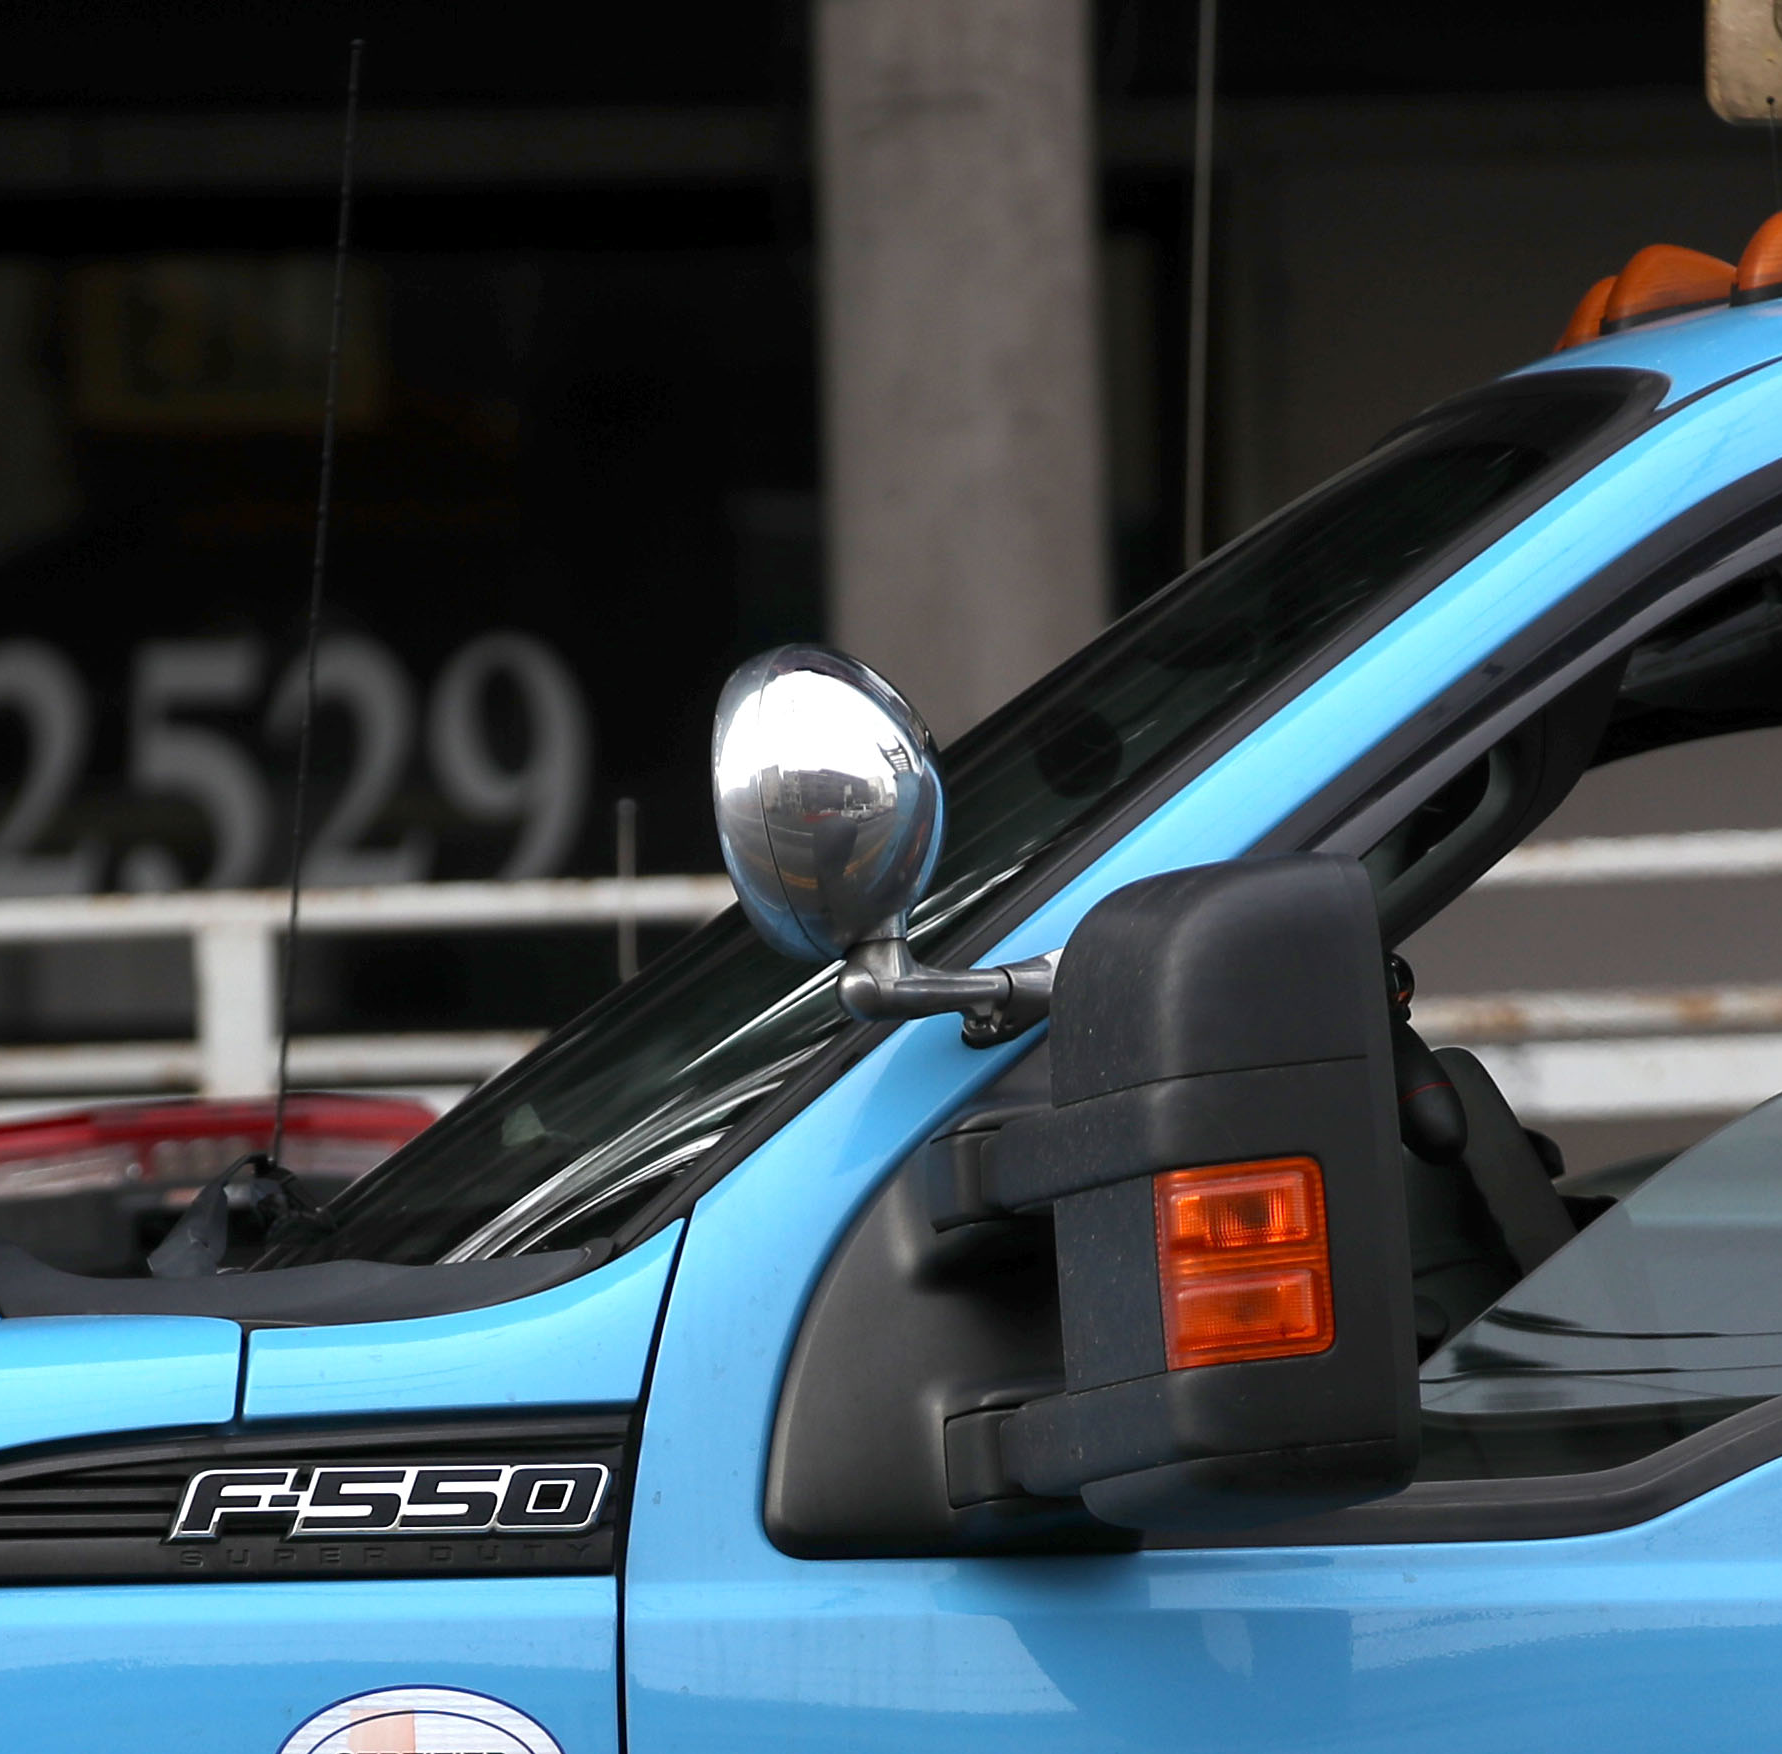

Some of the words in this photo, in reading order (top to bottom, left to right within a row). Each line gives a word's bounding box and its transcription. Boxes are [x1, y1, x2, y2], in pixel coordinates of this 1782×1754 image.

[168, 1464, 610, 1540] F-550
[179, 1546, 387, 1569] SUPER
[429, 1543, 595, 1566] DUTY
